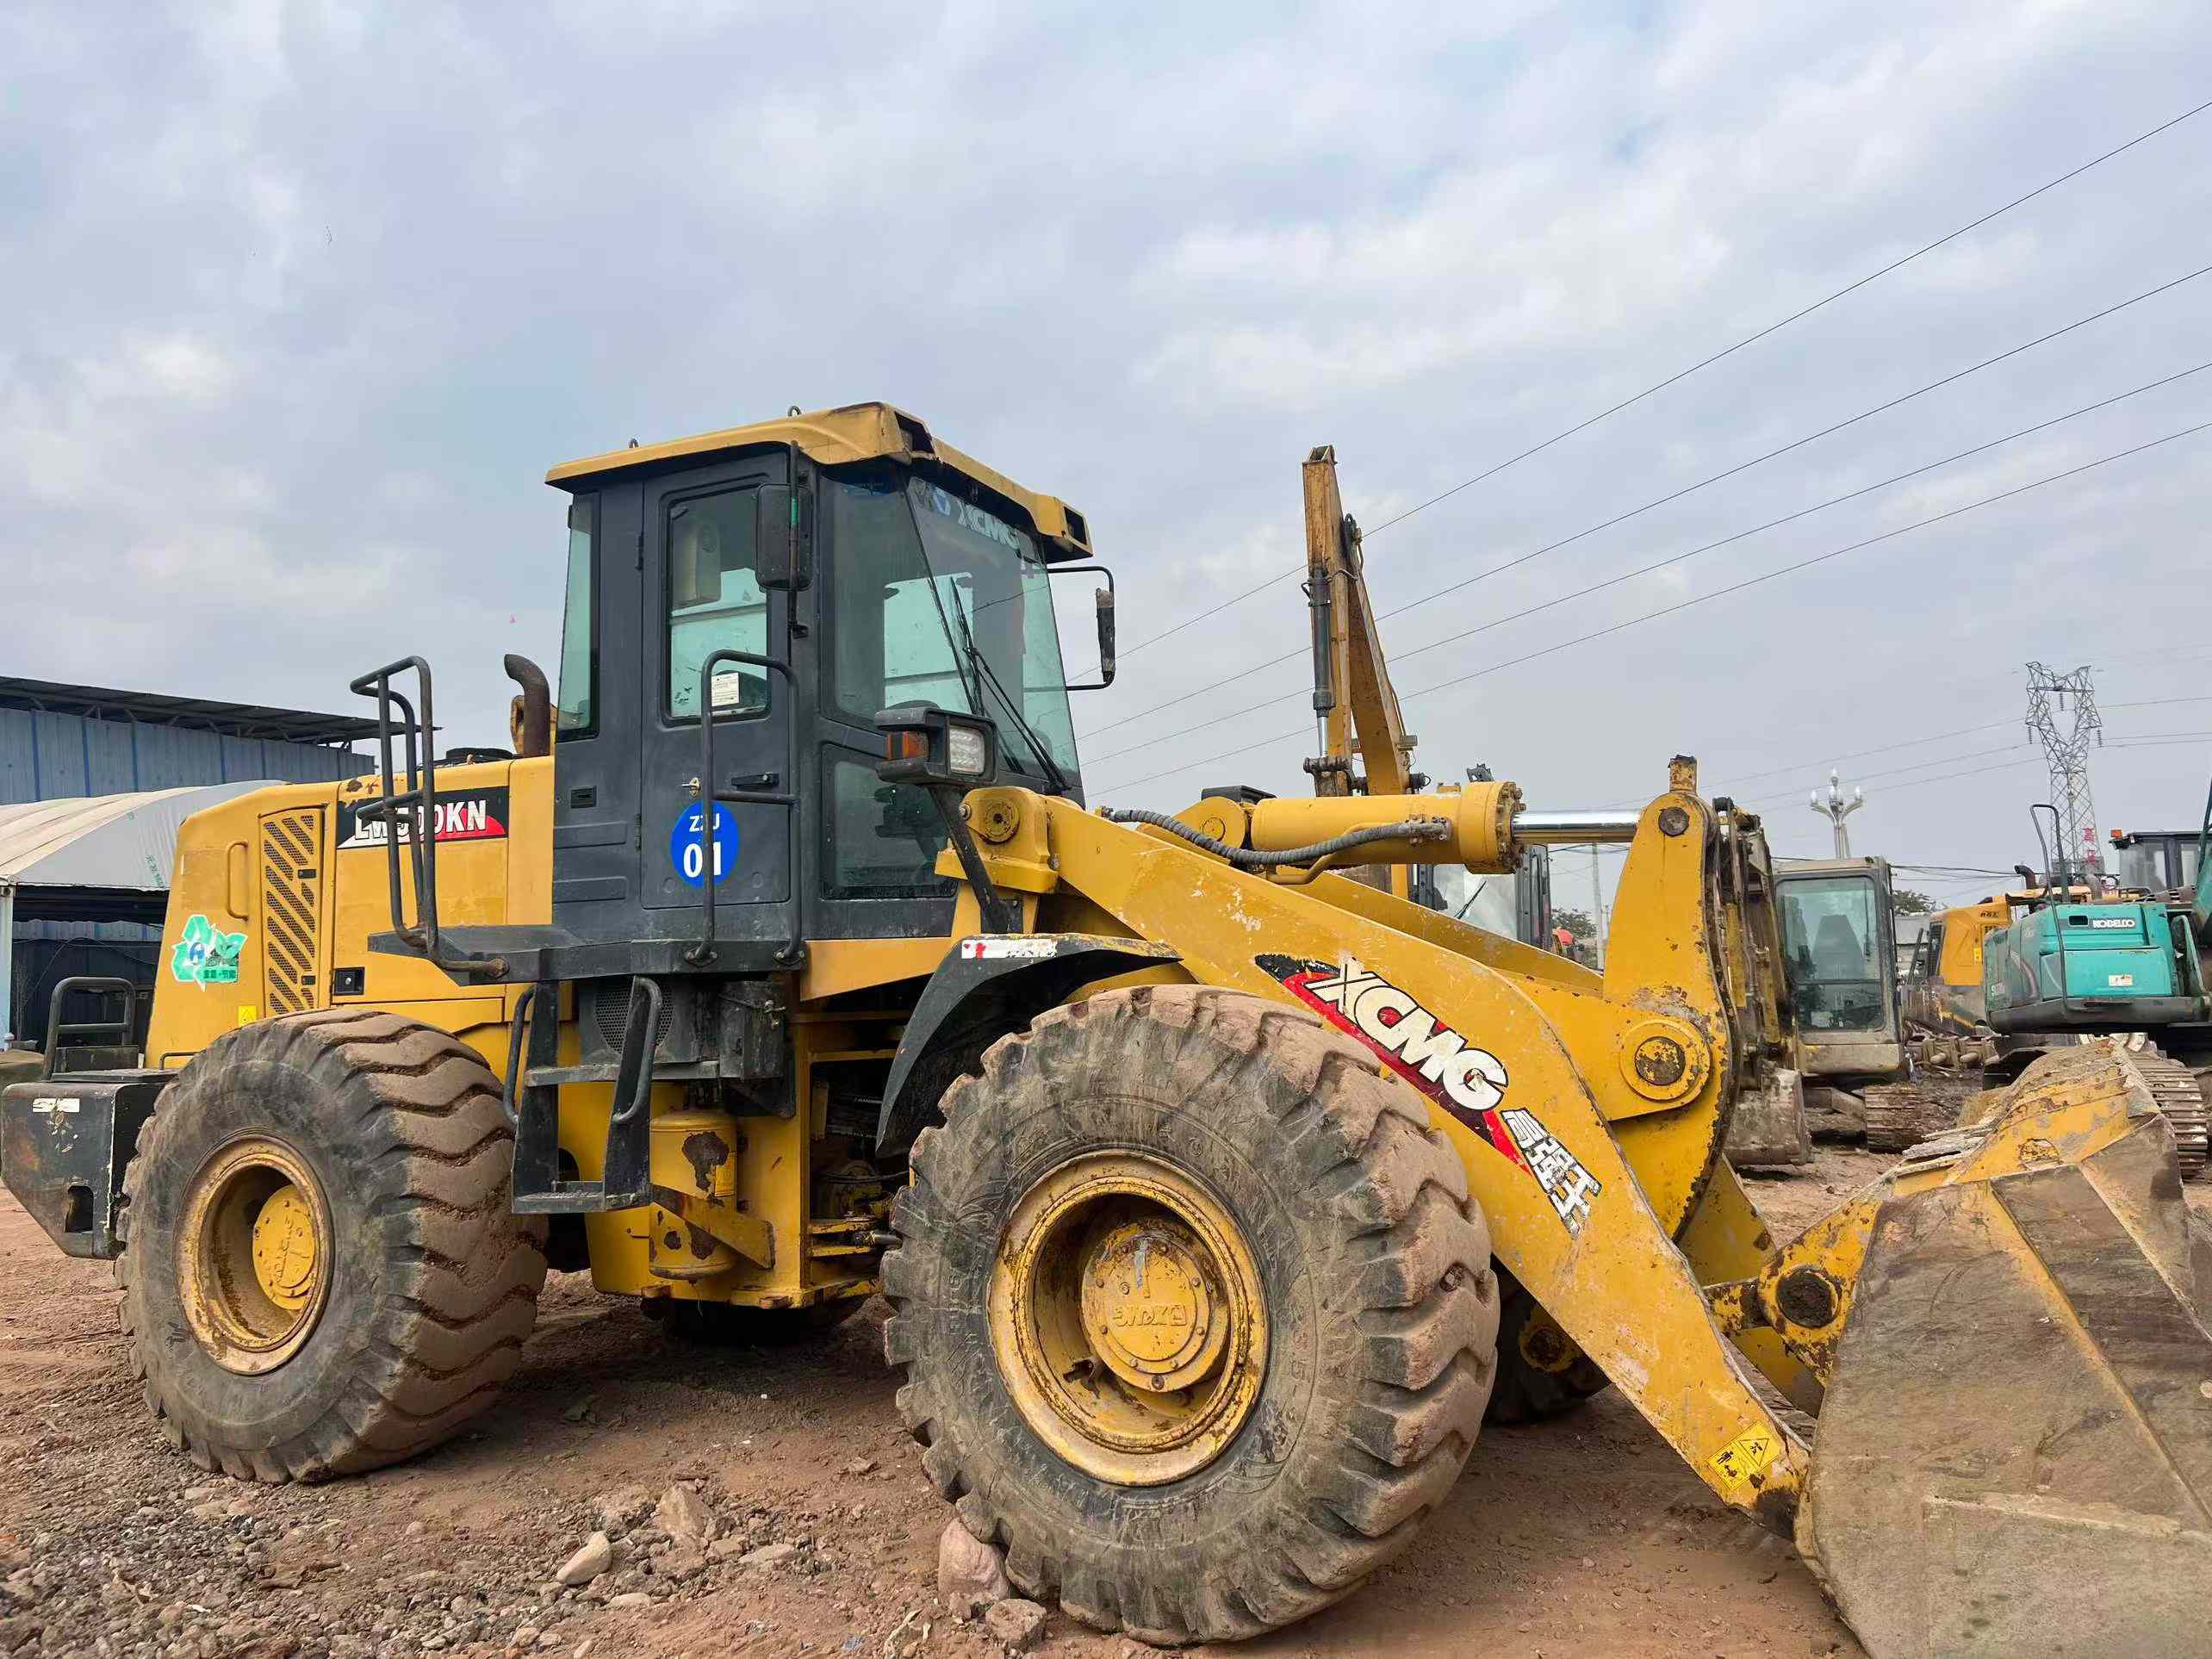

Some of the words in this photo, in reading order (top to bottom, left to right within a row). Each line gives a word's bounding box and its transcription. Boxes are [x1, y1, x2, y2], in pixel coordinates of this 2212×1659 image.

[355, 799, 487, 841] L50KN
[683, 841, 722, 878] 01
[2092, 918, 2135, 929] KOBELCO
[1302, 956, 1509, 1110] XCMG
